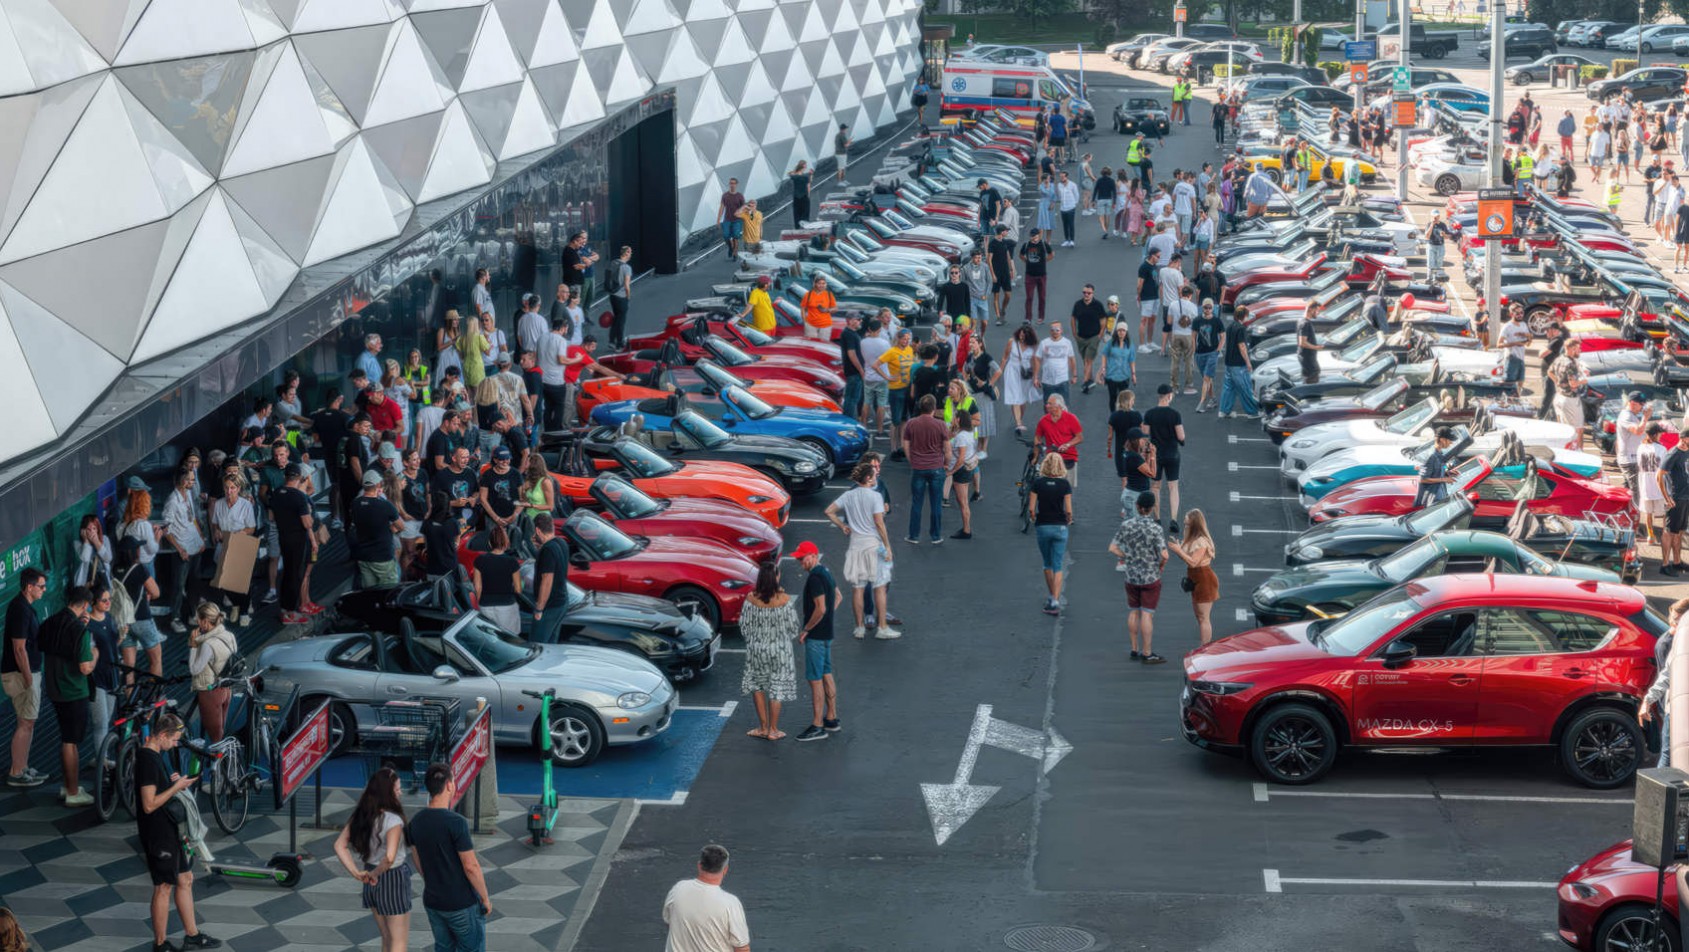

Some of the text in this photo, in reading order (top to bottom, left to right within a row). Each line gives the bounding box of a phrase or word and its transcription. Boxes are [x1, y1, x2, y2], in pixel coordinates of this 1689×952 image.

[12, 545, 31, 571] box
[1357, 718, 1454, 732] MAZDA CX-5
